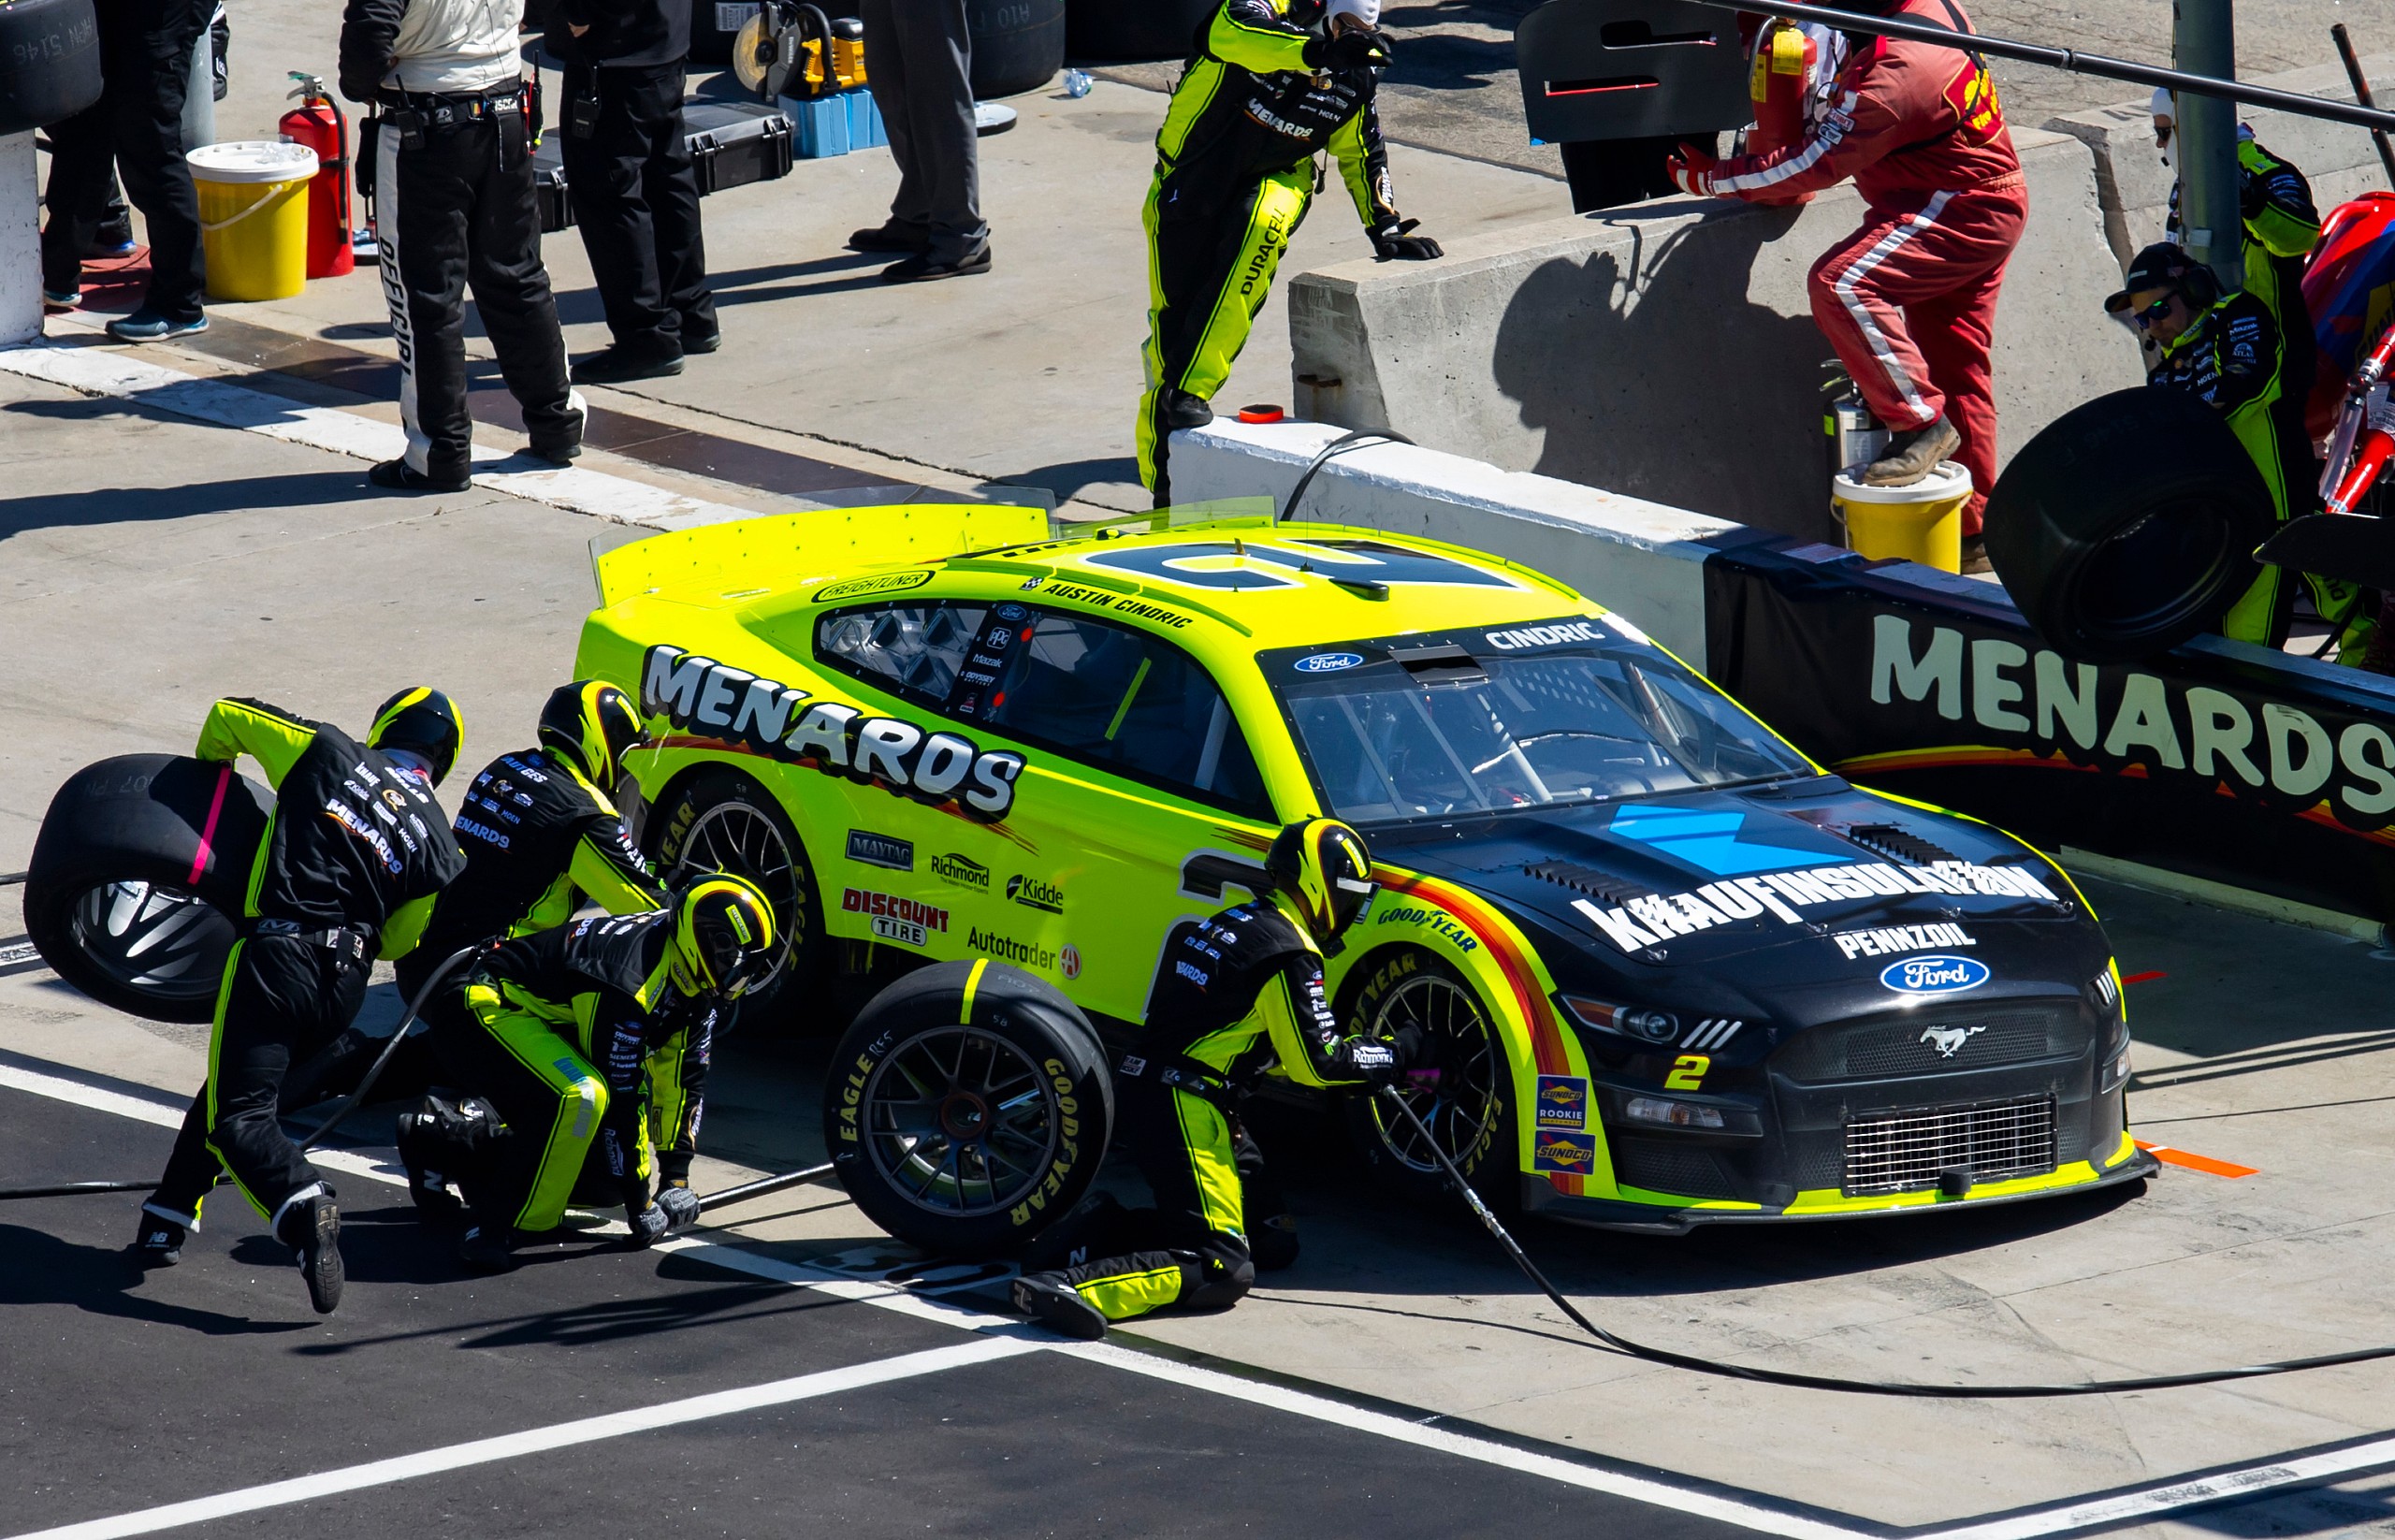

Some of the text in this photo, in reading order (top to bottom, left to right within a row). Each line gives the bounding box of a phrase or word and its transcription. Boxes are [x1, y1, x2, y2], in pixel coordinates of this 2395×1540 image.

[1241, 206, 1286, 297] DURACELL
[380, 236, 412, 376] OFFICIAL
[822, 574, 924, 598] FREIGHTLINER
[1001, 607, 1022, 618] Ford
[1043, 584, 1194, 629] AUSTIN CINDRIC
[1486, 623, 1605, 649] CINDRIC
[965, 672, 995, 683] ODYSSEY
[973, 654, 1003, 668] Mazak
[1306, 654, 1353, 671] Ford
[645, 645, 1023, 812] MENARDS
[1871, 615, 2395, 814] MENARDS
[455, 815, 510, 849] ENARDS
[501, 809, 521, 824] MOEN
[398, 827, 418, 852] MOEN
[852, 836, 910, 863] MAYTAG
[931, 855, 990, 888] Richmond
[1023, 877, 1064, 907] Kidde
[841, 887, 950, 934] DISCOUNT
[1571, 876, 1804, 952] KNAUF
[877, 919, 922, 944] TIRE
[1377, 908, 1478, 954] GOODYEAR
[1834, 922, 1977, 960] PENNZOIL
[967, 926, 1056, 970] Autotrader
[1900, 958, 1975, 991] Ford
[993, 1014, 1009, 1027] 58
[1353, 1048, 1394, 1065] Rchmond
[1664, 1054, 1711, 1092] 2
[839, 1053, 875, 1142] EAGLE
[1543, 1090, 1582, 1101] SUNOCO
[1540, 1110, 1583, 1120] ROOKIE
[604, 1126, 624, 1177] Richmond
[1009, 1058, 1080, 1227] GOODYEAR
[1538, 1145, 1591, 1161] SUNOCO
